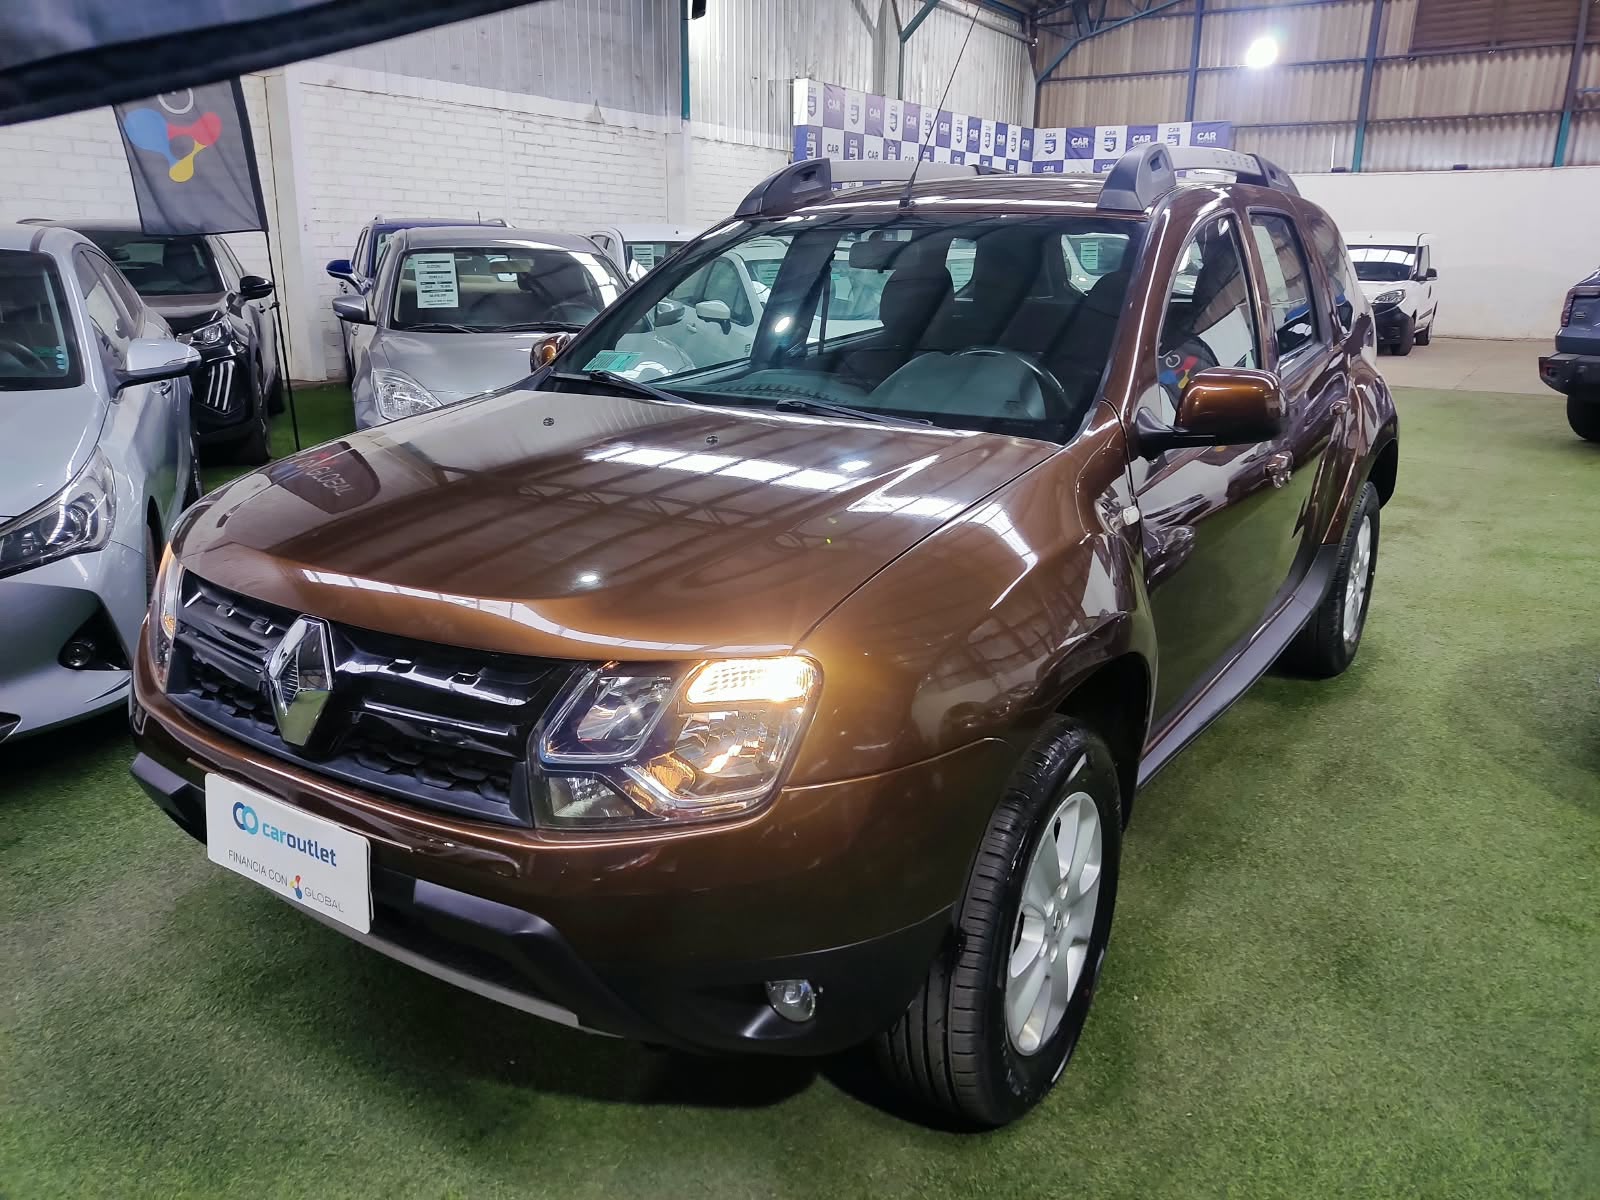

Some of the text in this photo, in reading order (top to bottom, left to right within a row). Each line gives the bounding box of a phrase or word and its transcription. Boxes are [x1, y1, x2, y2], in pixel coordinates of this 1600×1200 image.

[827, 99, 841, 112] CAR
[869, 107, 881, 118] CAR
[1071, 137, 1089, 145] CAR
[1132, 134, 1151, 143] CAR
[1197, 131, 1217, 141] CAR
[827, 143, 840, 153] CAR
[868, 150, 879, 159] CAR
[263, 823, 336, 867] caroutlet
[228, 849, 345, 912] FINANCIA CON GLOBAL
